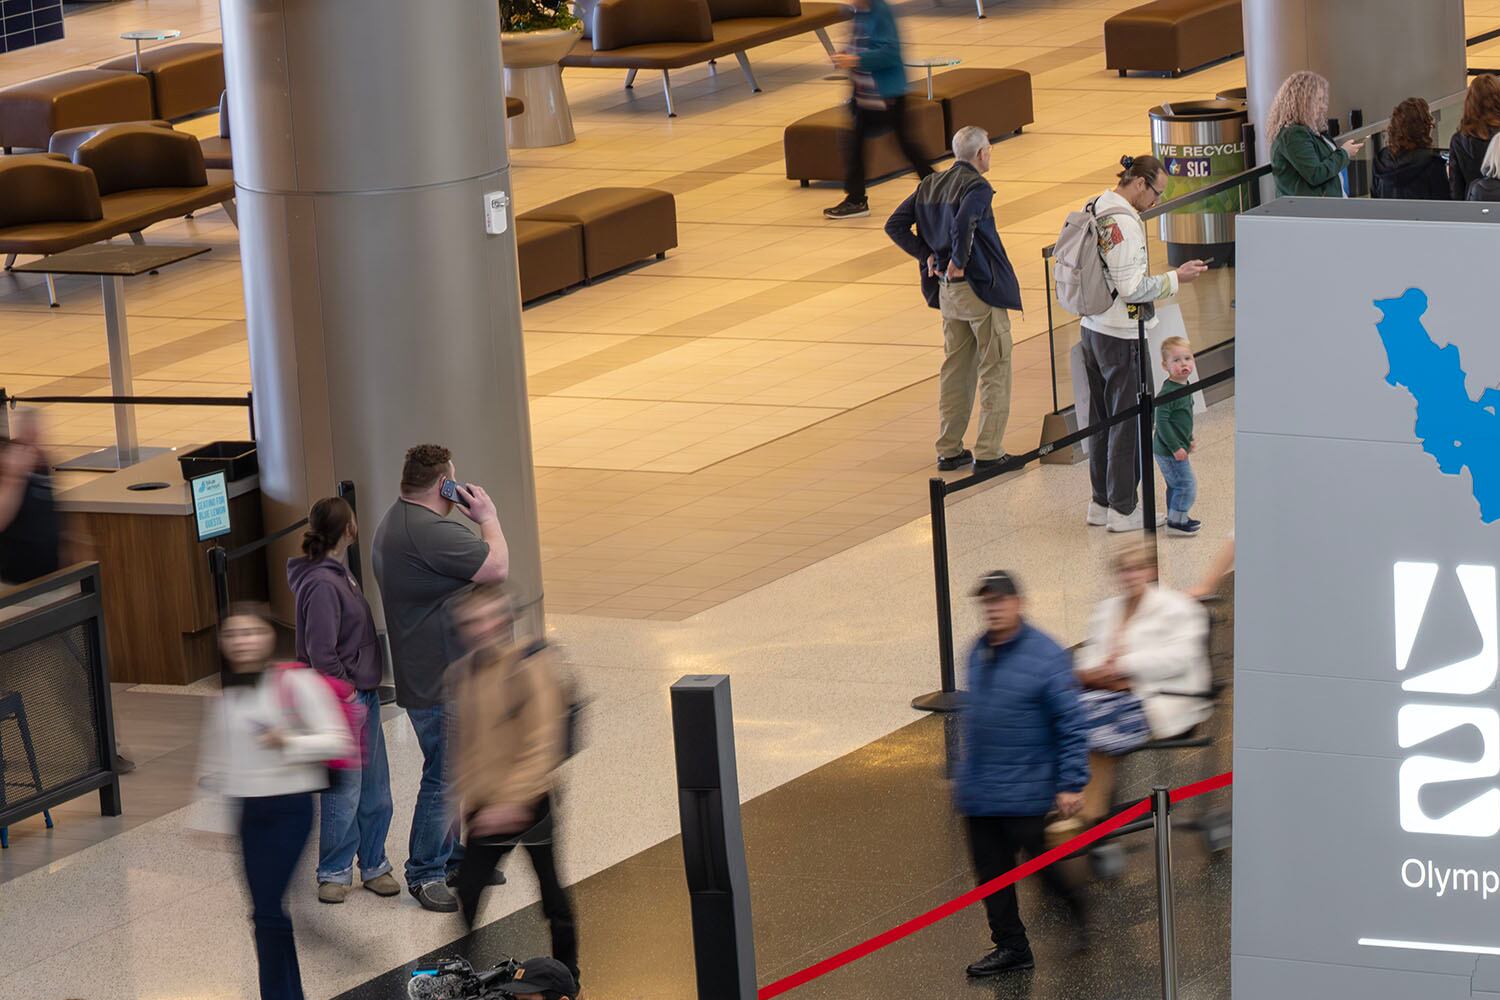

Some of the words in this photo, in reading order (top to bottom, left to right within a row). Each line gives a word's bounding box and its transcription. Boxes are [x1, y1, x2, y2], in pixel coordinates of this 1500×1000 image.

[1159, 145, 1177, 156] WE
[1183, 143, 1245, 157] RECYCLE
[1187, 161, 1208, 177] SLC
